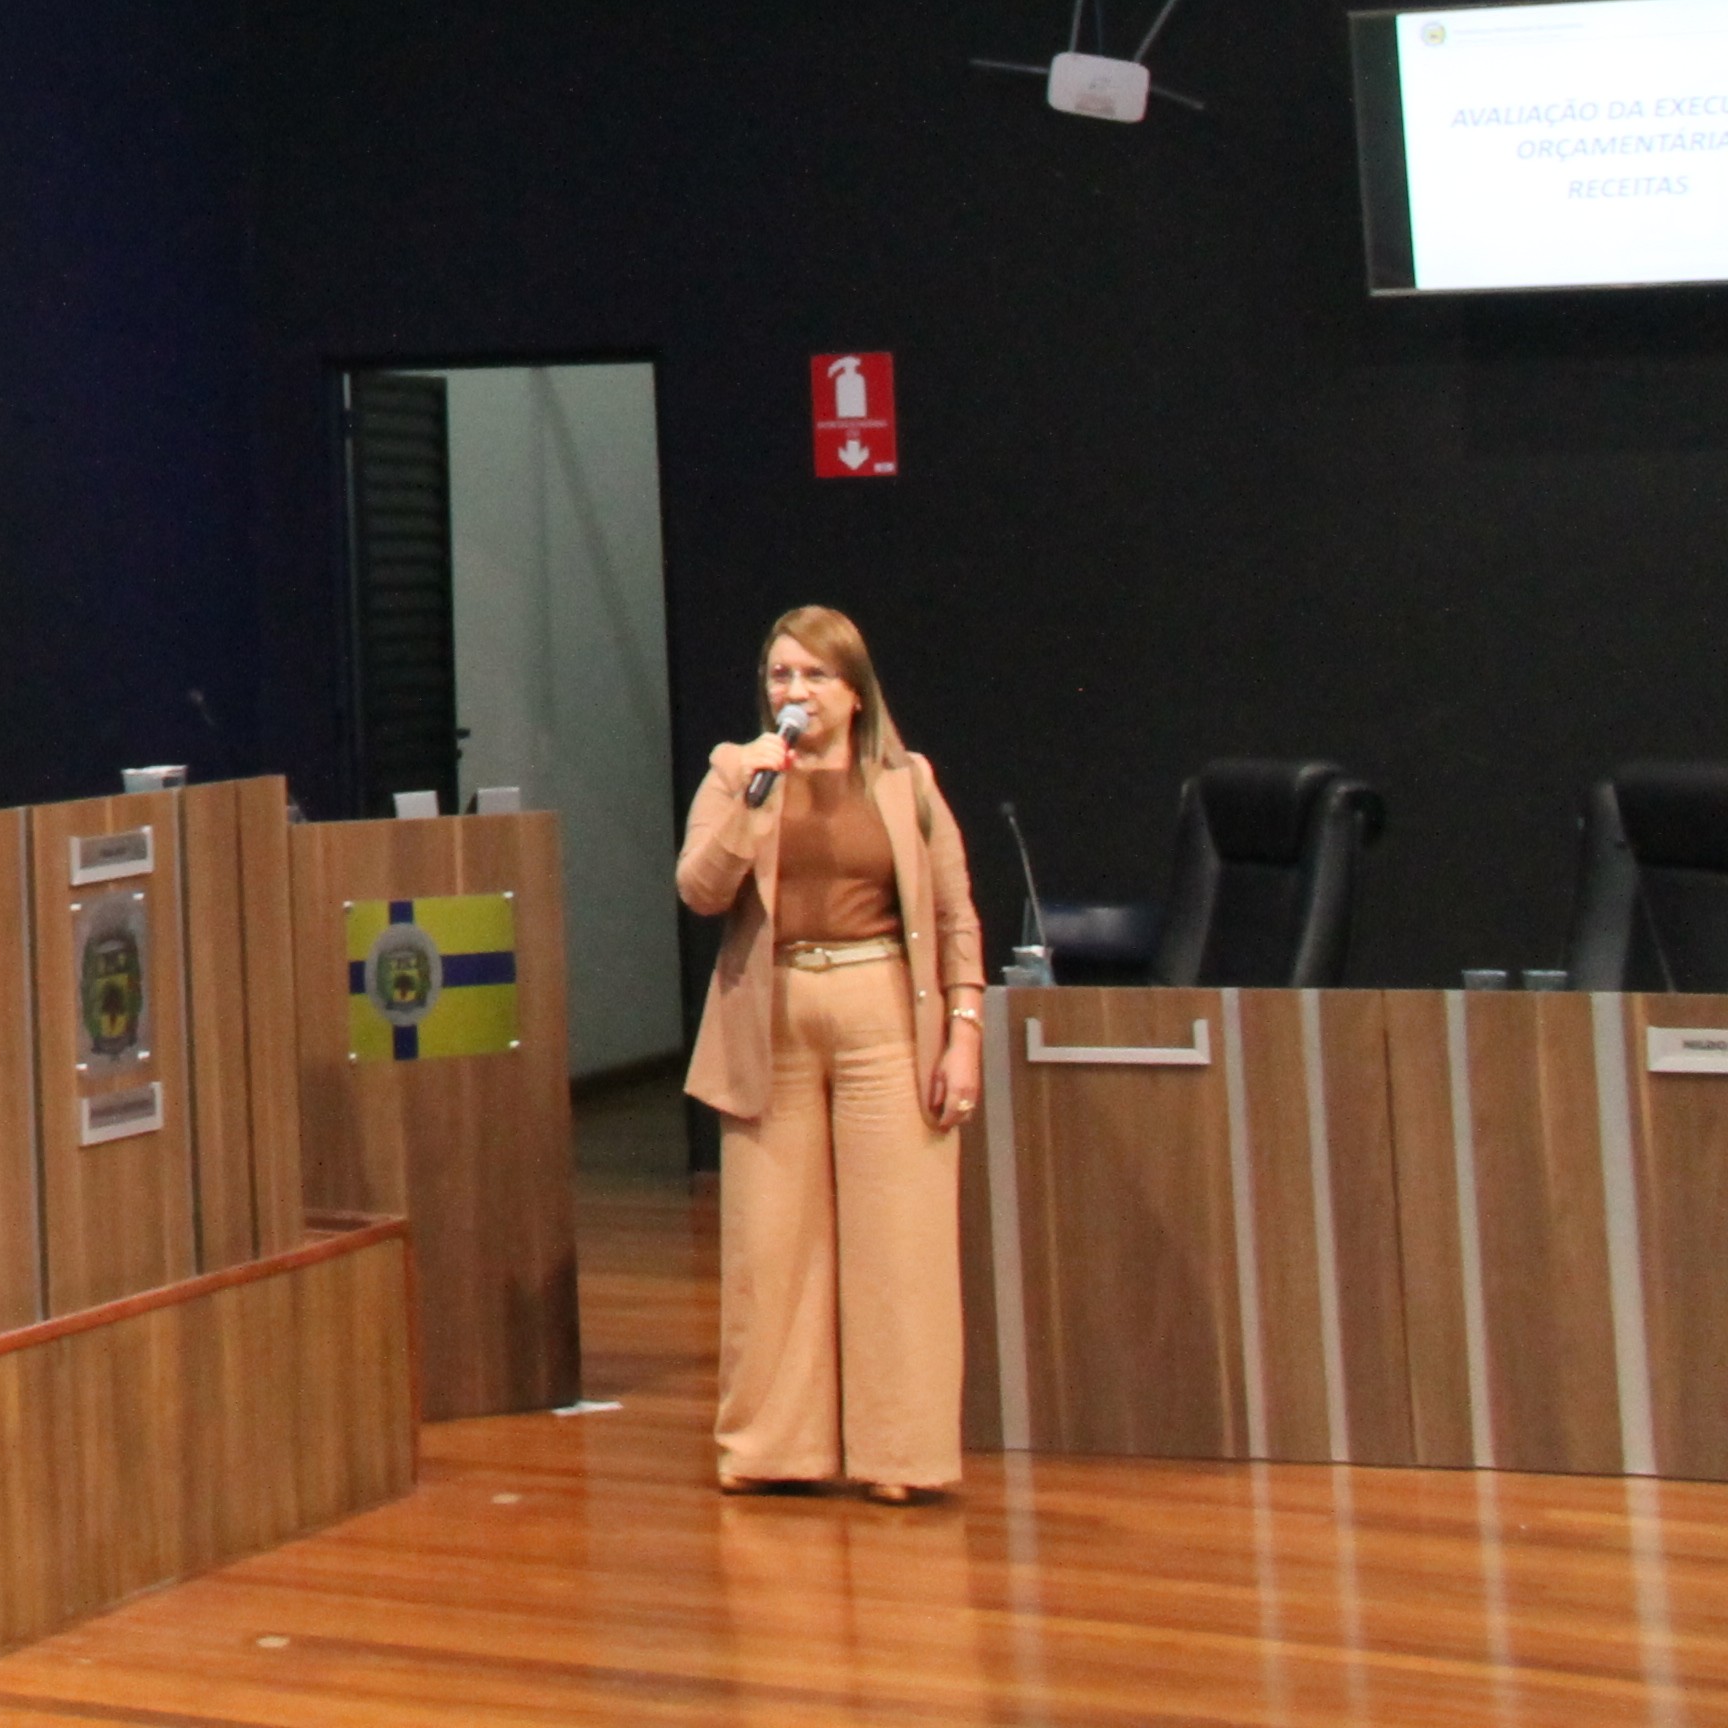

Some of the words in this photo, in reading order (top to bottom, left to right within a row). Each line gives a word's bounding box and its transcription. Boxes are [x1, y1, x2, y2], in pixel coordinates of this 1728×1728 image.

[1450, 98, 1599, 129] AVALIAÇÃO
[1607, 100, 1645, 121] DA
[1568, 176, 1689, 200] RECEITAS
